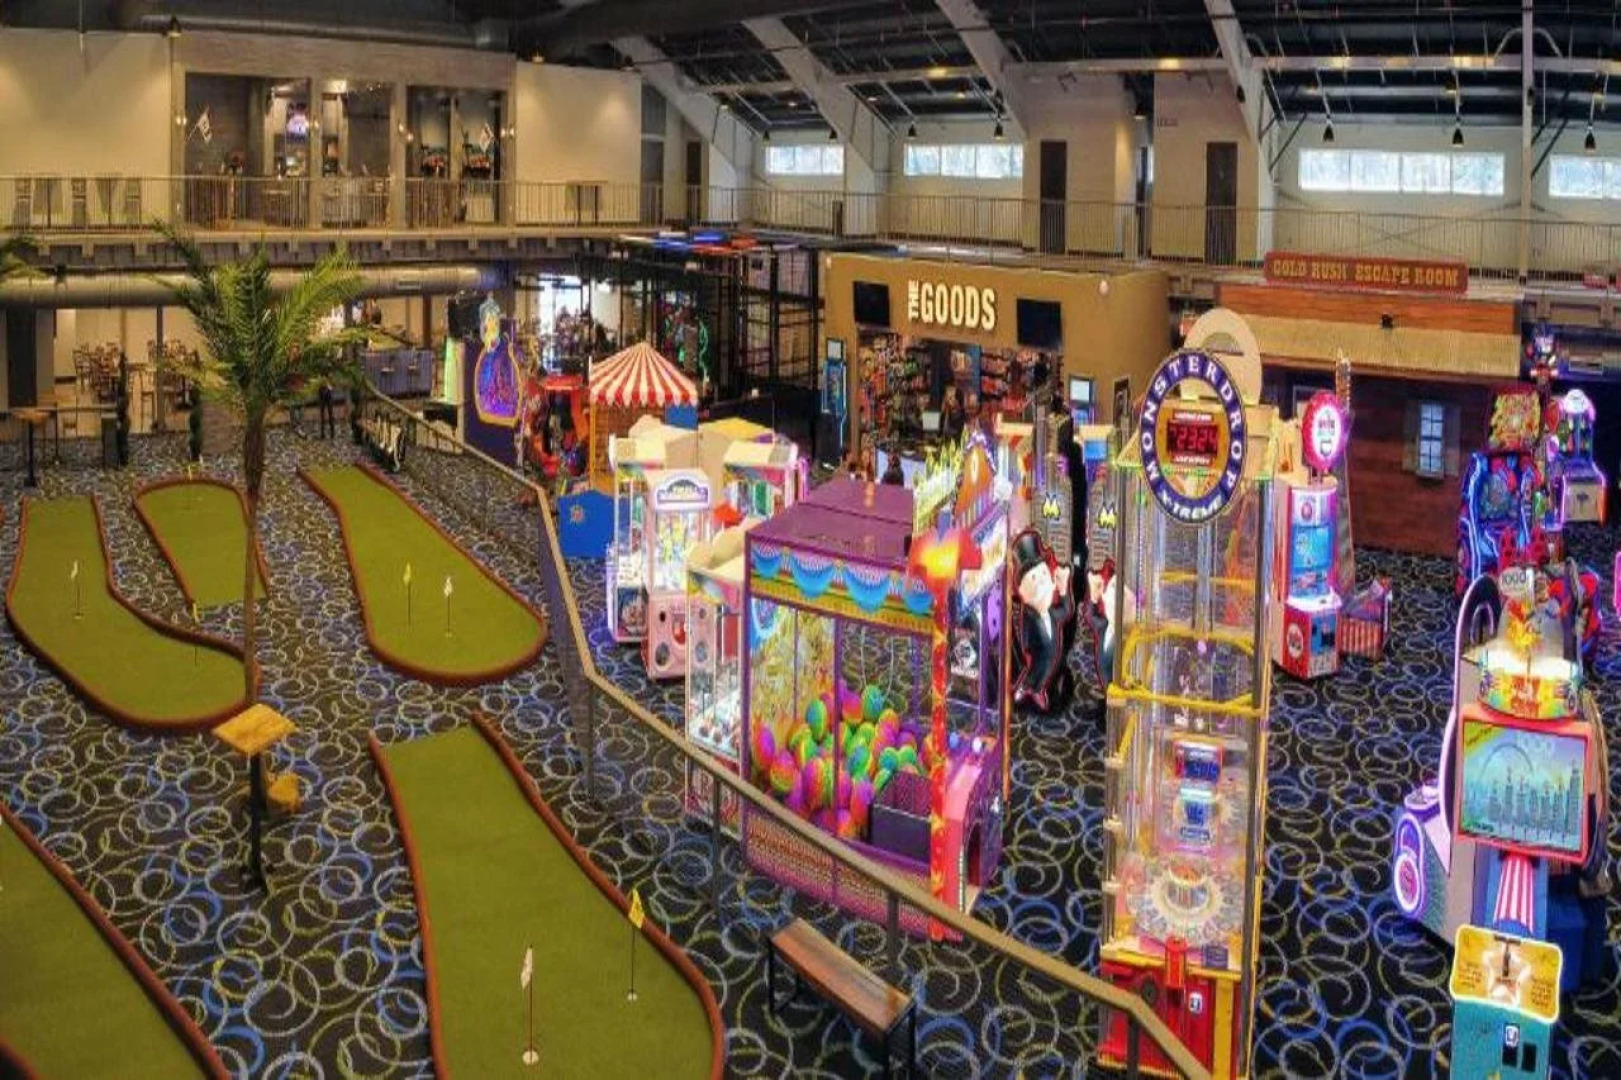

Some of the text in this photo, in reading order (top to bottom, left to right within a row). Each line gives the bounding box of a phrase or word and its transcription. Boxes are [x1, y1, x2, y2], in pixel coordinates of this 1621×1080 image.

[1273, 259, 1460, 287] GOLD RUSH ESCAPE ROOM
[908, 279, 996, 331] THE GOODS
